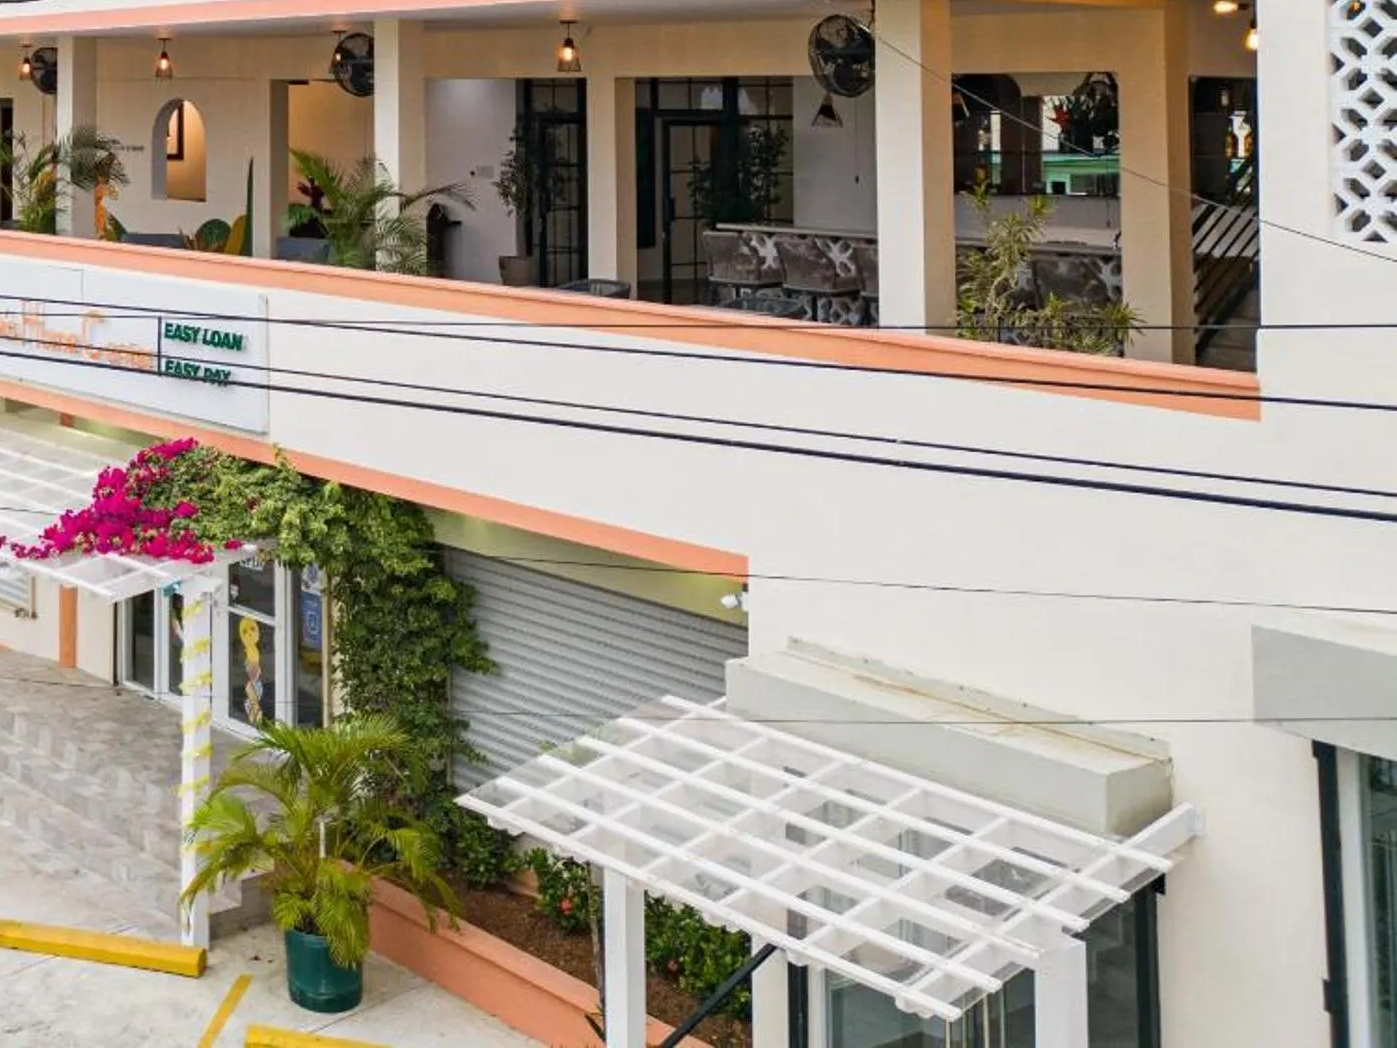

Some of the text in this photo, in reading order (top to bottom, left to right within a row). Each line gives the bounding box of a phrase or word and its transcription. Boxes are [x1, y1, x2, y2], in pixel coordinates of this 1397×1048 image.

[164, 322, 243, 351] EASY LOAN
[165, 359, 201, 381] EASY
